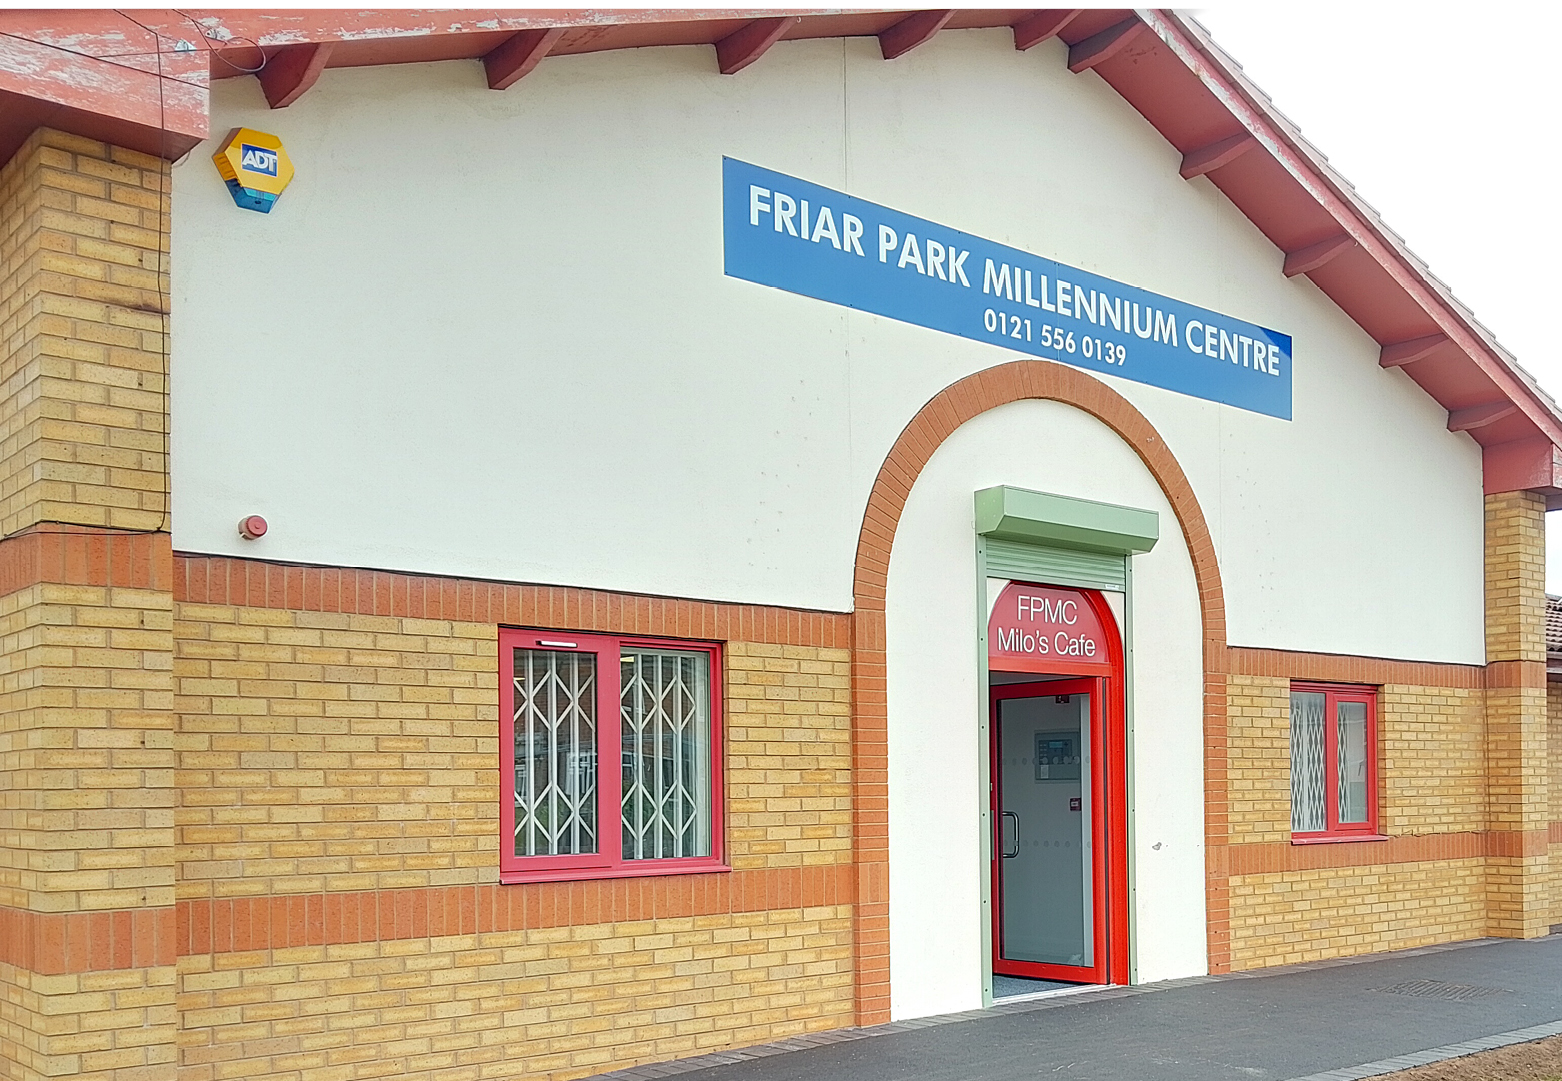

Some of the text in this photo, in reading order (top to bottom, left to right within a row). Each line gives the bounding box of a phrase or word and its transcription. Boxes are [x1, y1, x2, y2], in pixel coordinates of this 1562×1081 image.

[241, 149, 278, 172] ADT
[748, 184, 1281, 377] FRIAR PARK MILLENNIUM CENTRE
[983, 308, 1127, 368] 0121 556 0139
[1017, 595, 1078, 625] FPMC
[997, 627, 1096, 657] Milo's Cafe
